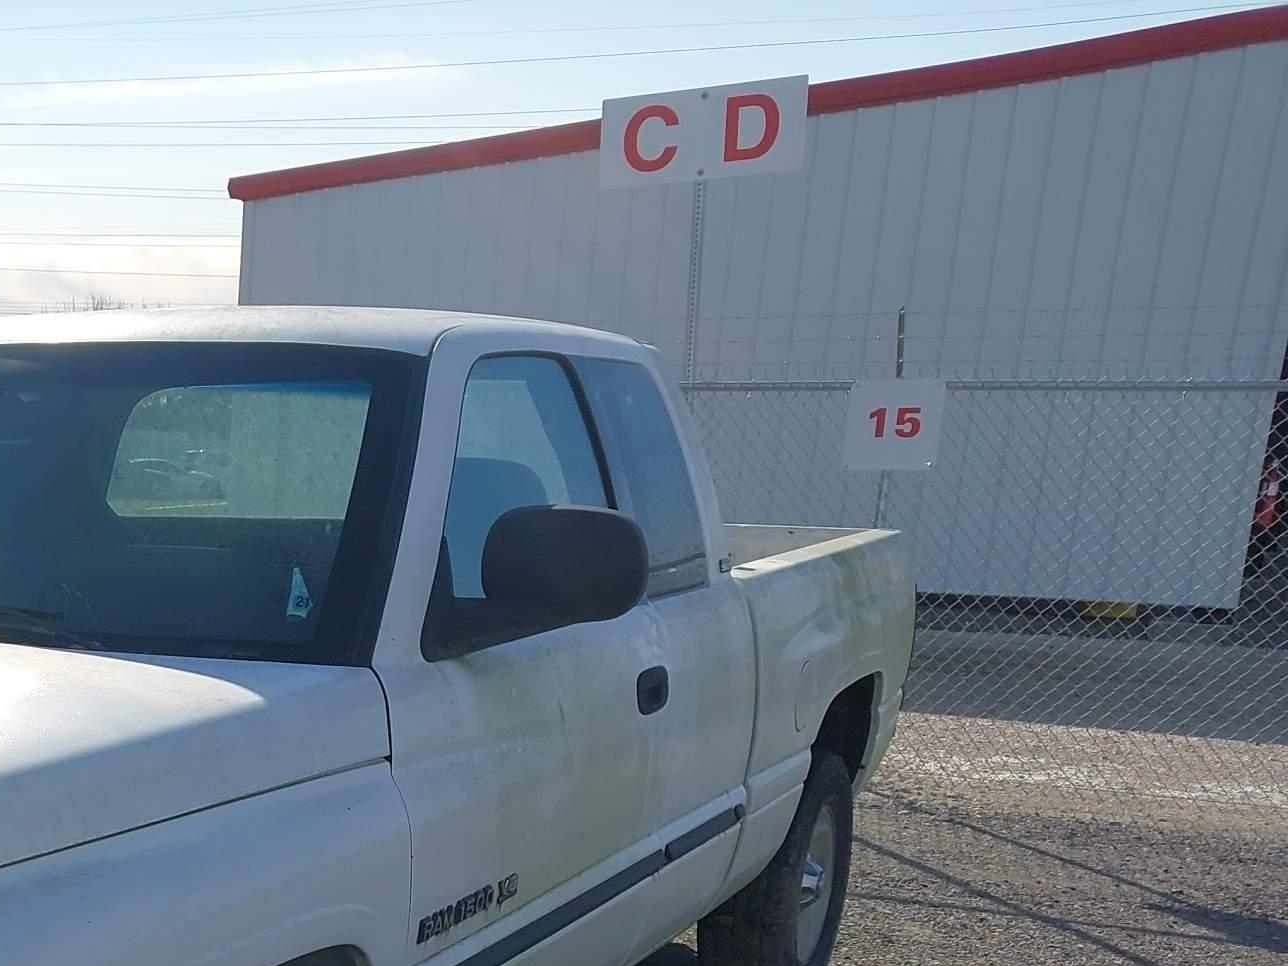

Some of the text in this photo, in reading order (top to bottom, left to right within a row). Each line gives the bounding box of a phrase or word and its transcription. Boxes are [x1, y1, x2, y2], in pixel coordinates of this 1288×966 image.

[623, 94, 780, 173] C D
[869, 407, 922, 439] 15
[416, 904, 454, 945] RAM
